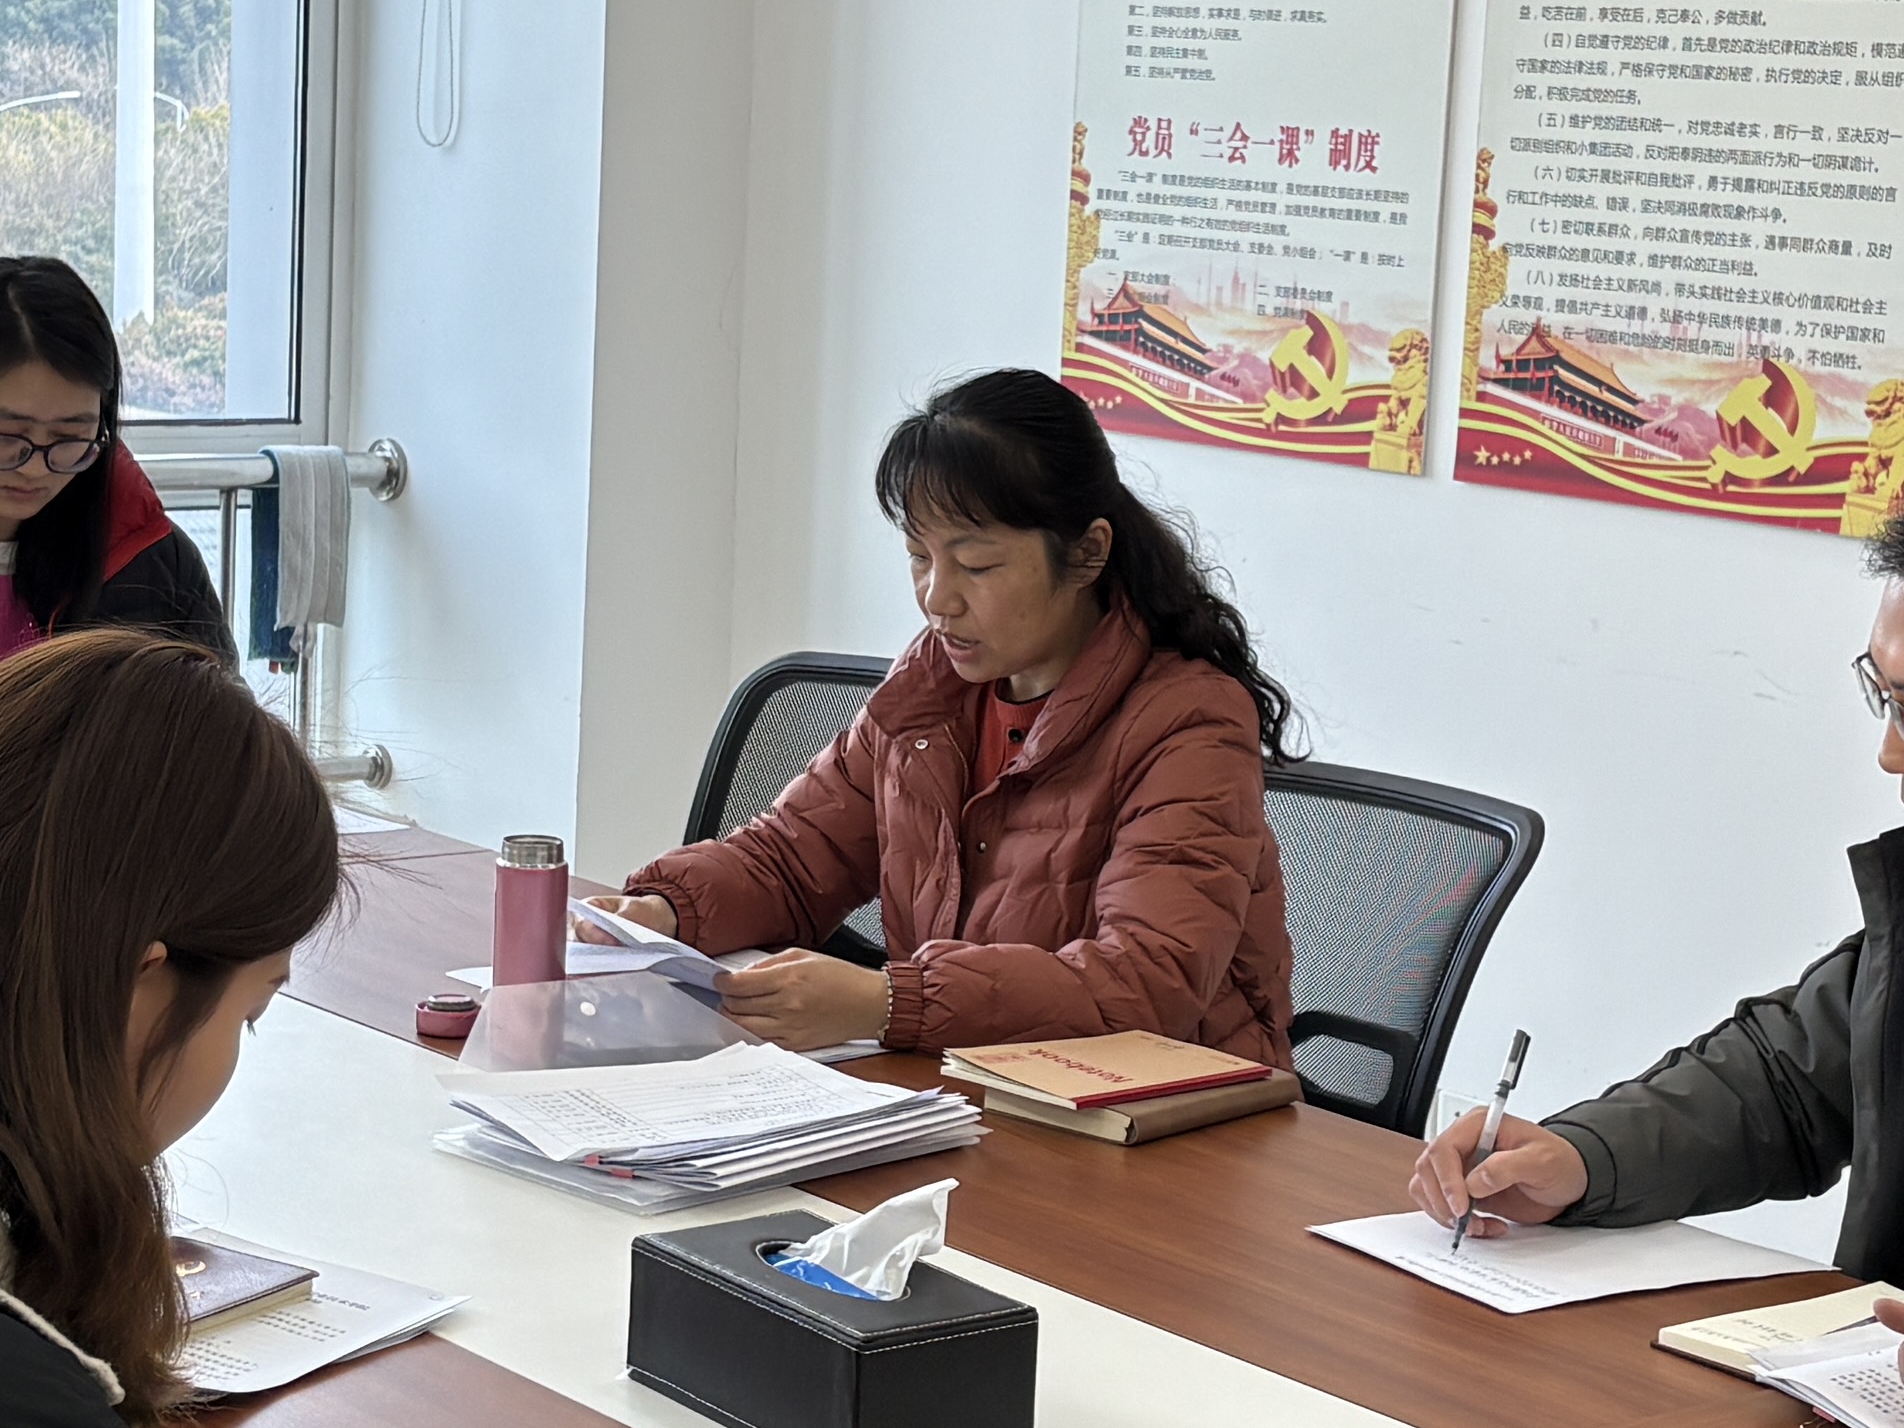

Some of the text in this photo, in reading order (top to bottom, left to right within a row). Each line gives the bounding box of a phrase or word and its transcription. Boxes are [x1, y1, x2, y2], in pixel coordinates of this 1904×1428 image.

[1127, 115, 1381, 174] 党员“三会一课”制度
